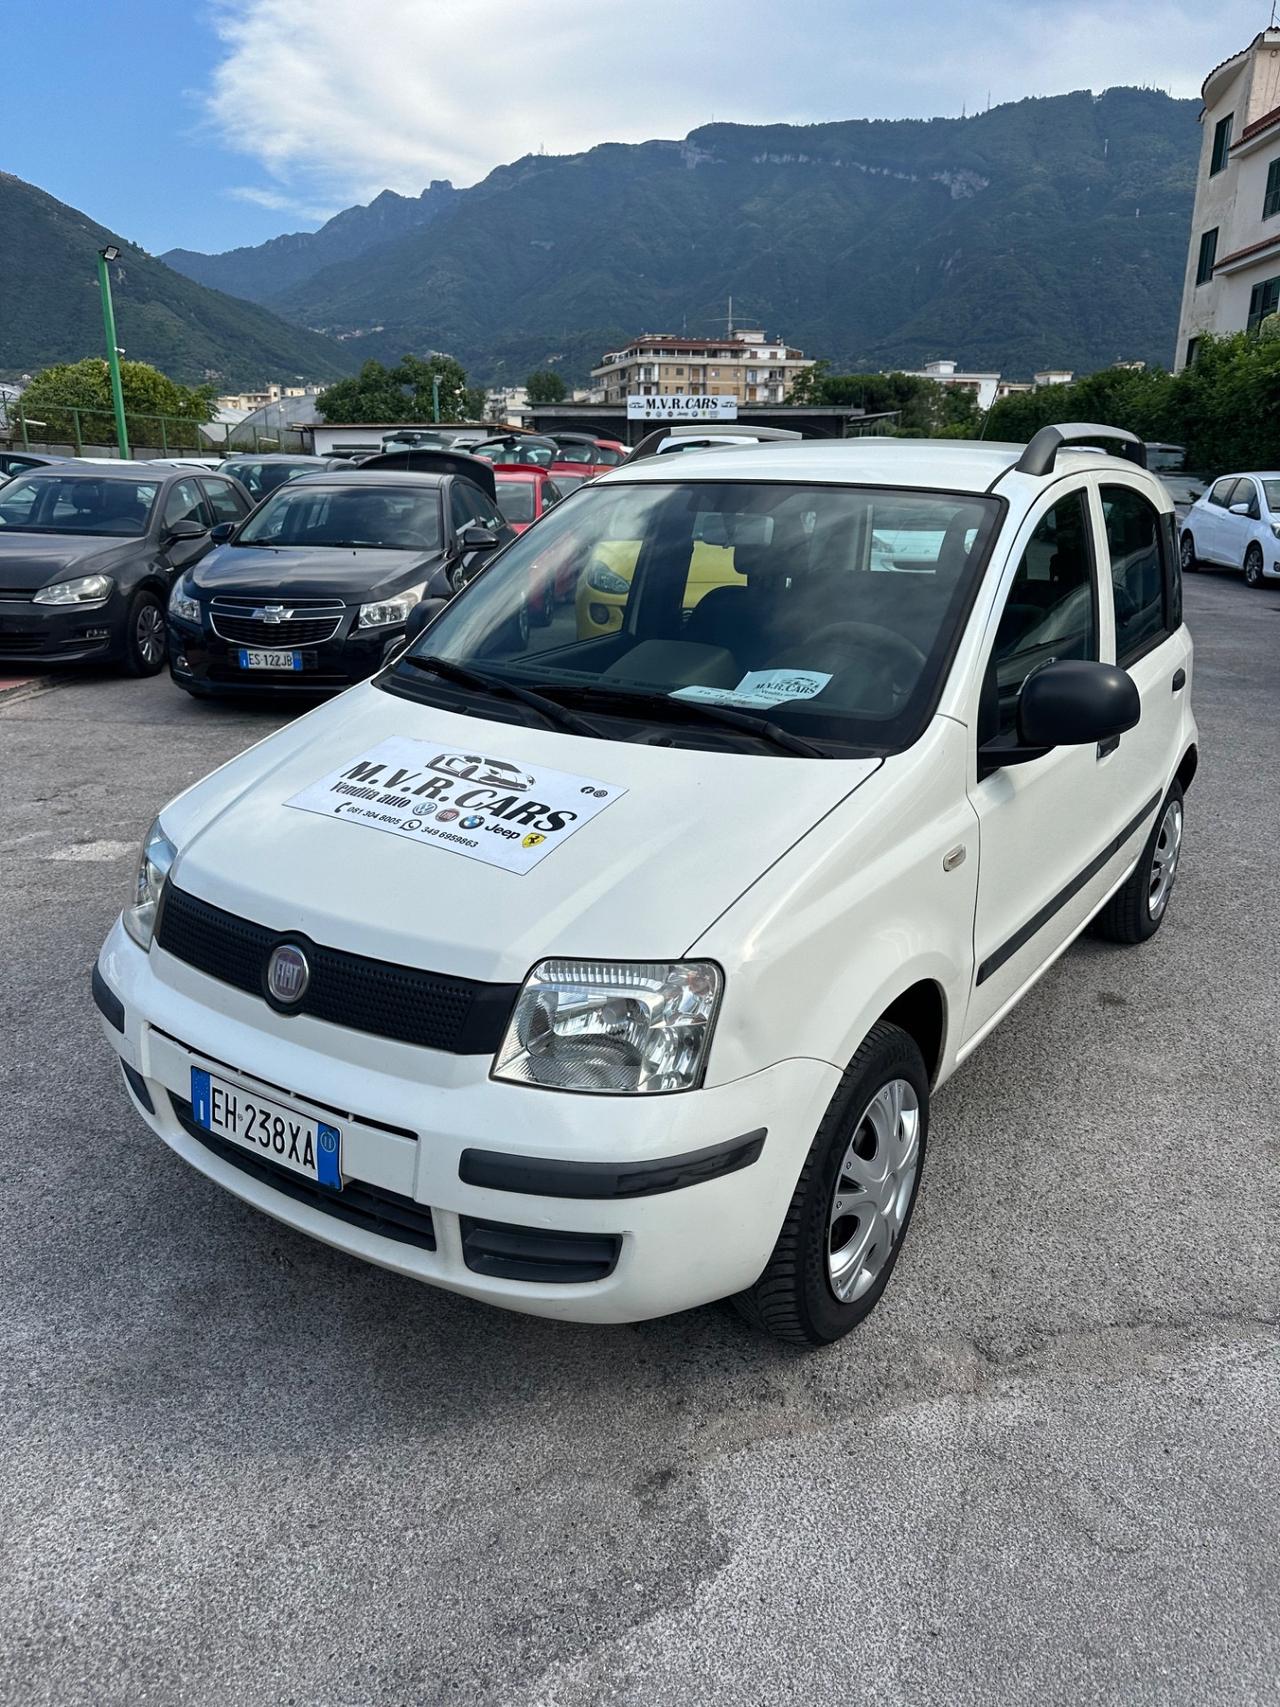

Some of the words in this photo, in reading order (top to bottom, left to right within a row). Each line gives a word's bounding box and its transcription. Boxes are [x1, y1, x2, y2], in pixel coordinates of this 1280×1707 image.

[330, 781, 380, 800] Vendita
[376, 794, 412, 808] auto
[346, 806, 364, 815] 081
[362, 810, 380, 819] 304
[421, 826, 440, 836] 349
[439, 831, 479, 848] 6959863
[484, 824, 521, 840] Jeep
[275, 959, 301, 990] FIAT
